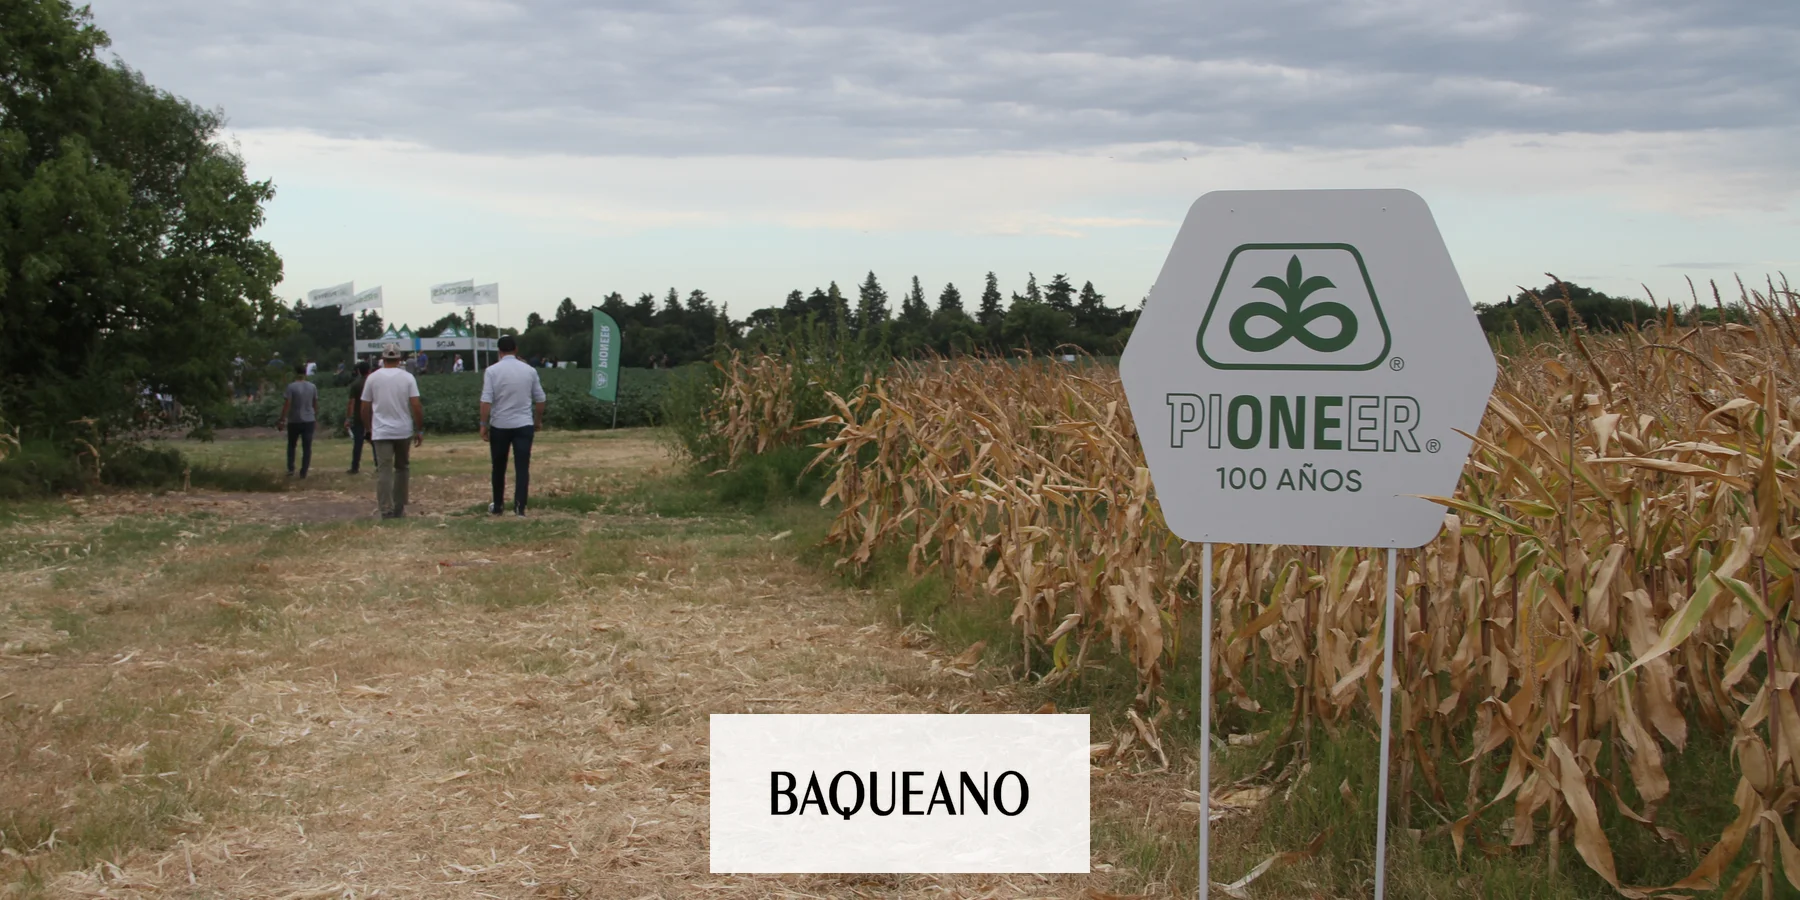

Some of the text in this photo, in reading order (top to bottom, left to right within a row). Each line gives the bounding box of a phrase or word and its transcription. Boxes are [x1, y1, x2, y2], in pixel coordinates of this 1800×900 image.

[1166, 393, 1421, 453] PIONEER
[1216, 463, 1363, 493] 100 AÑOS
